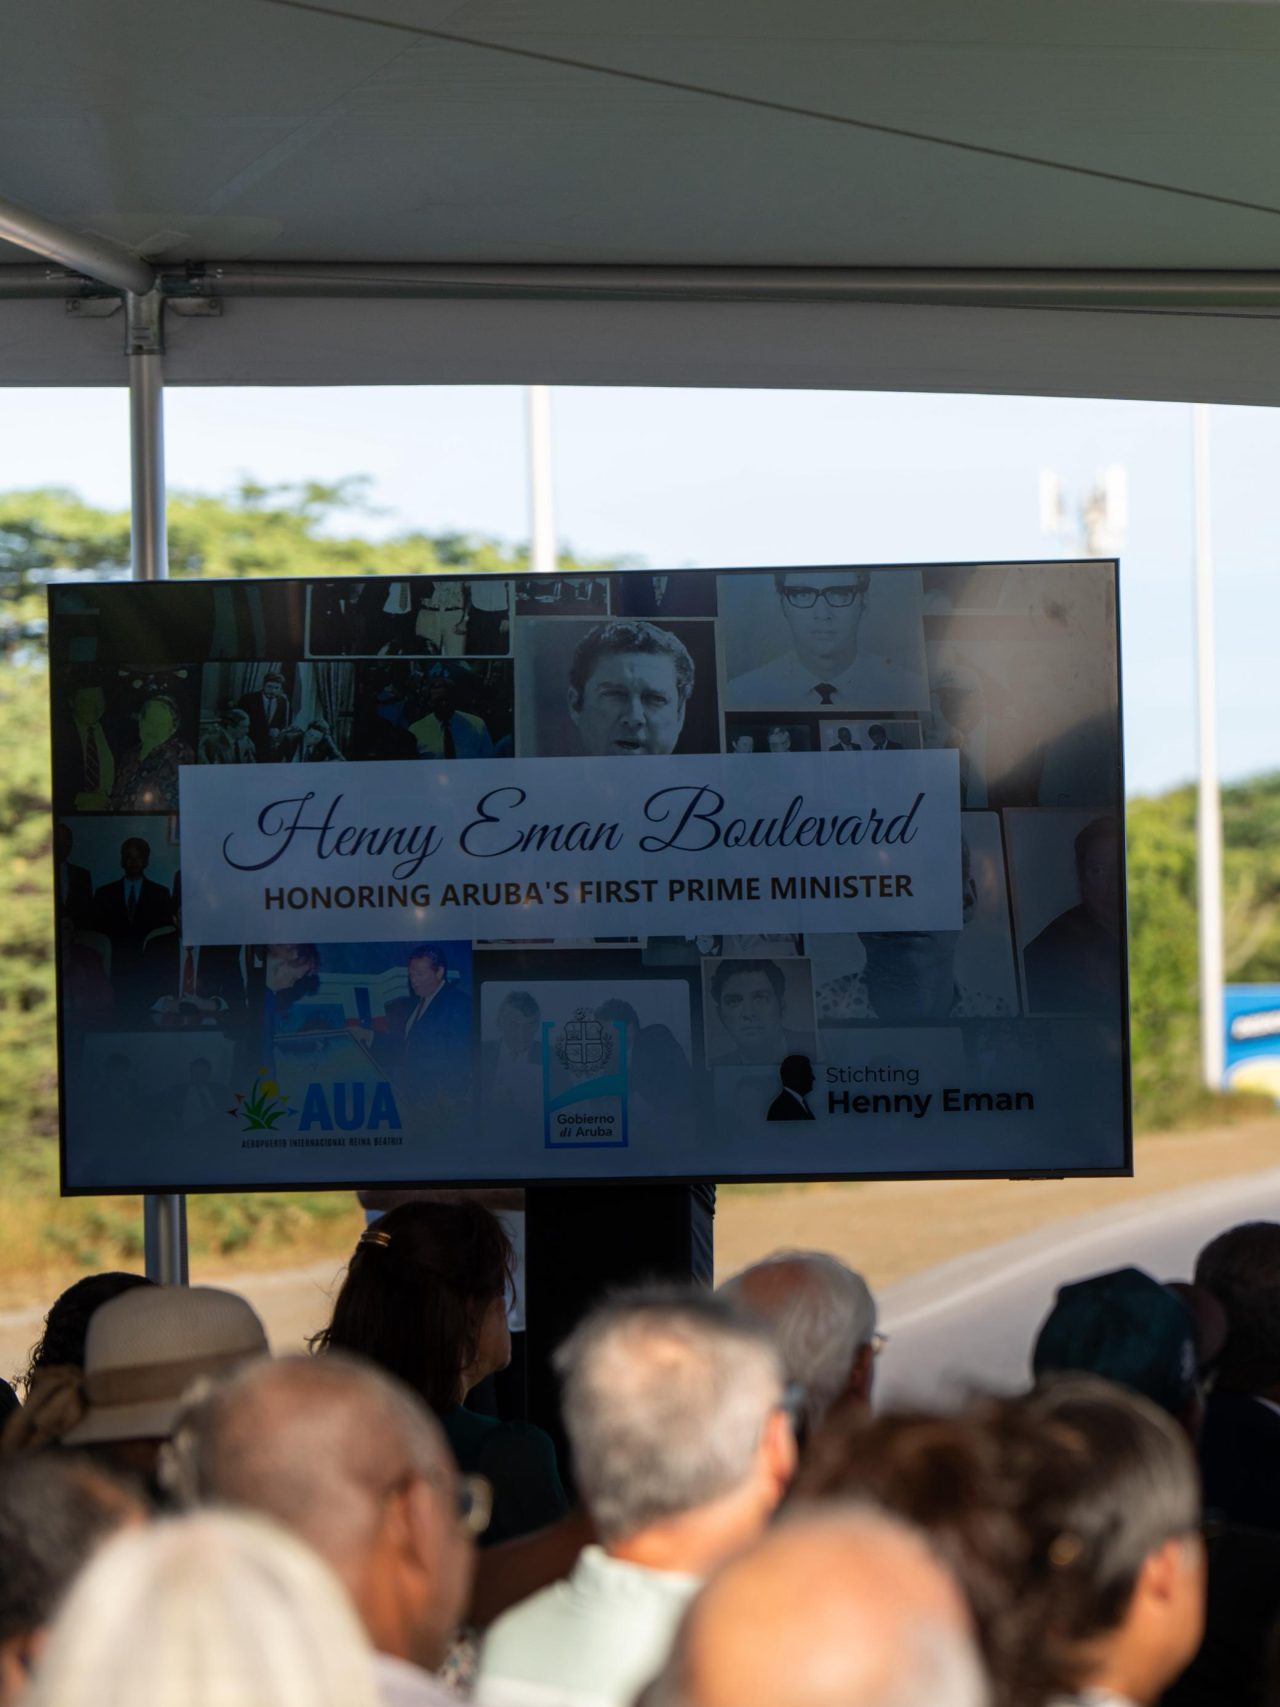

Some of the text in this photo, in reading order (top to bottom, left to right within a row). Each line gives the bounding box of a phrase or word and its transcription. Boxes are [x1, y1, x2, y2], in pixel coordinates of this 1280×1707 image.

[222, 784, 927, 881] Henny Eman Boulevard
[264, 873, 914, 910] HONORING ARUBA'S FIRST PRIME MINISTER
[827, 1066, 920, 1086] Stichting
[299, 1083, 402, 1131] AUA
[828, 1088, 1034, 1118] Henny Eman
[558, 1114, 614, 1125] Gobierno
[560, 1126, 612, 1137] di Aruba
[289, 1138, 346, 1147] INTERNACIONAL
[349, 1137, 371, 1146] REINA
[374, 1136, 403, 1146] BEATRIX
